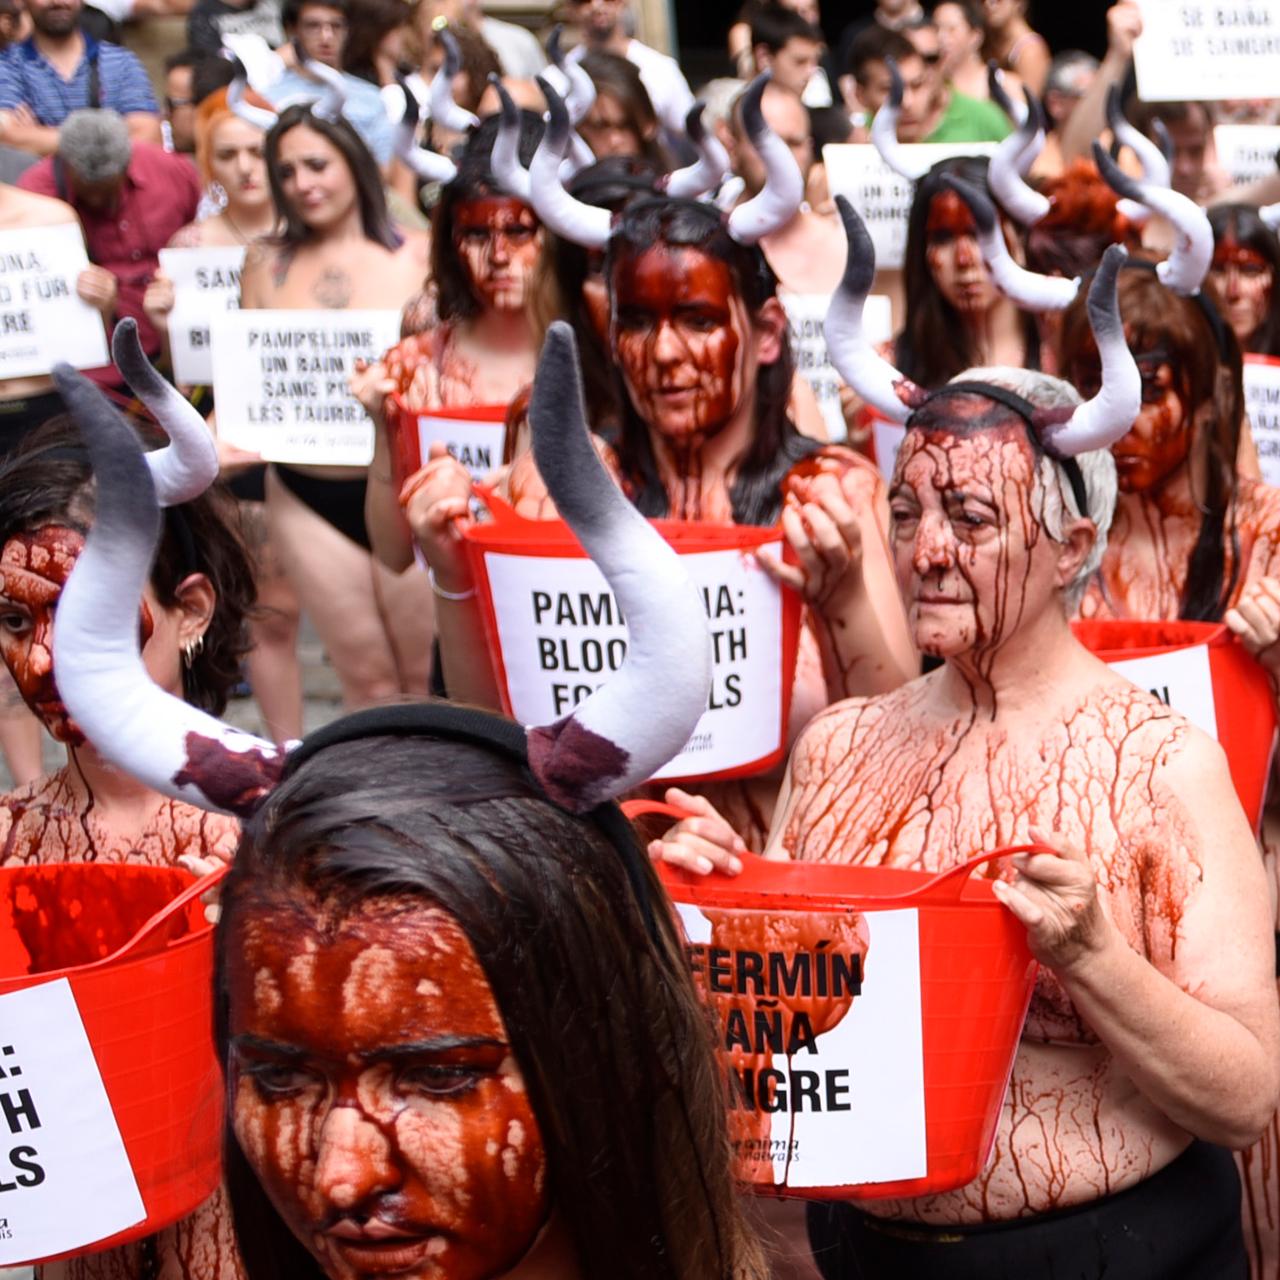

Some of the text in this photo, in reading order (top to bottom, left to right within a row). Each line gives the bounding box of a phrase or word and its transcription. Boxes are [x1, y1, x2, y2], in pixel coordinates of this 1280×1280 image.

[537, 626, 748, 673] BLOOTH
[686, 939, 862, 997] FERMÍN
[725, 999, 819, 1055] AÑA
[729, 1068, 851, 1114] NGRE
